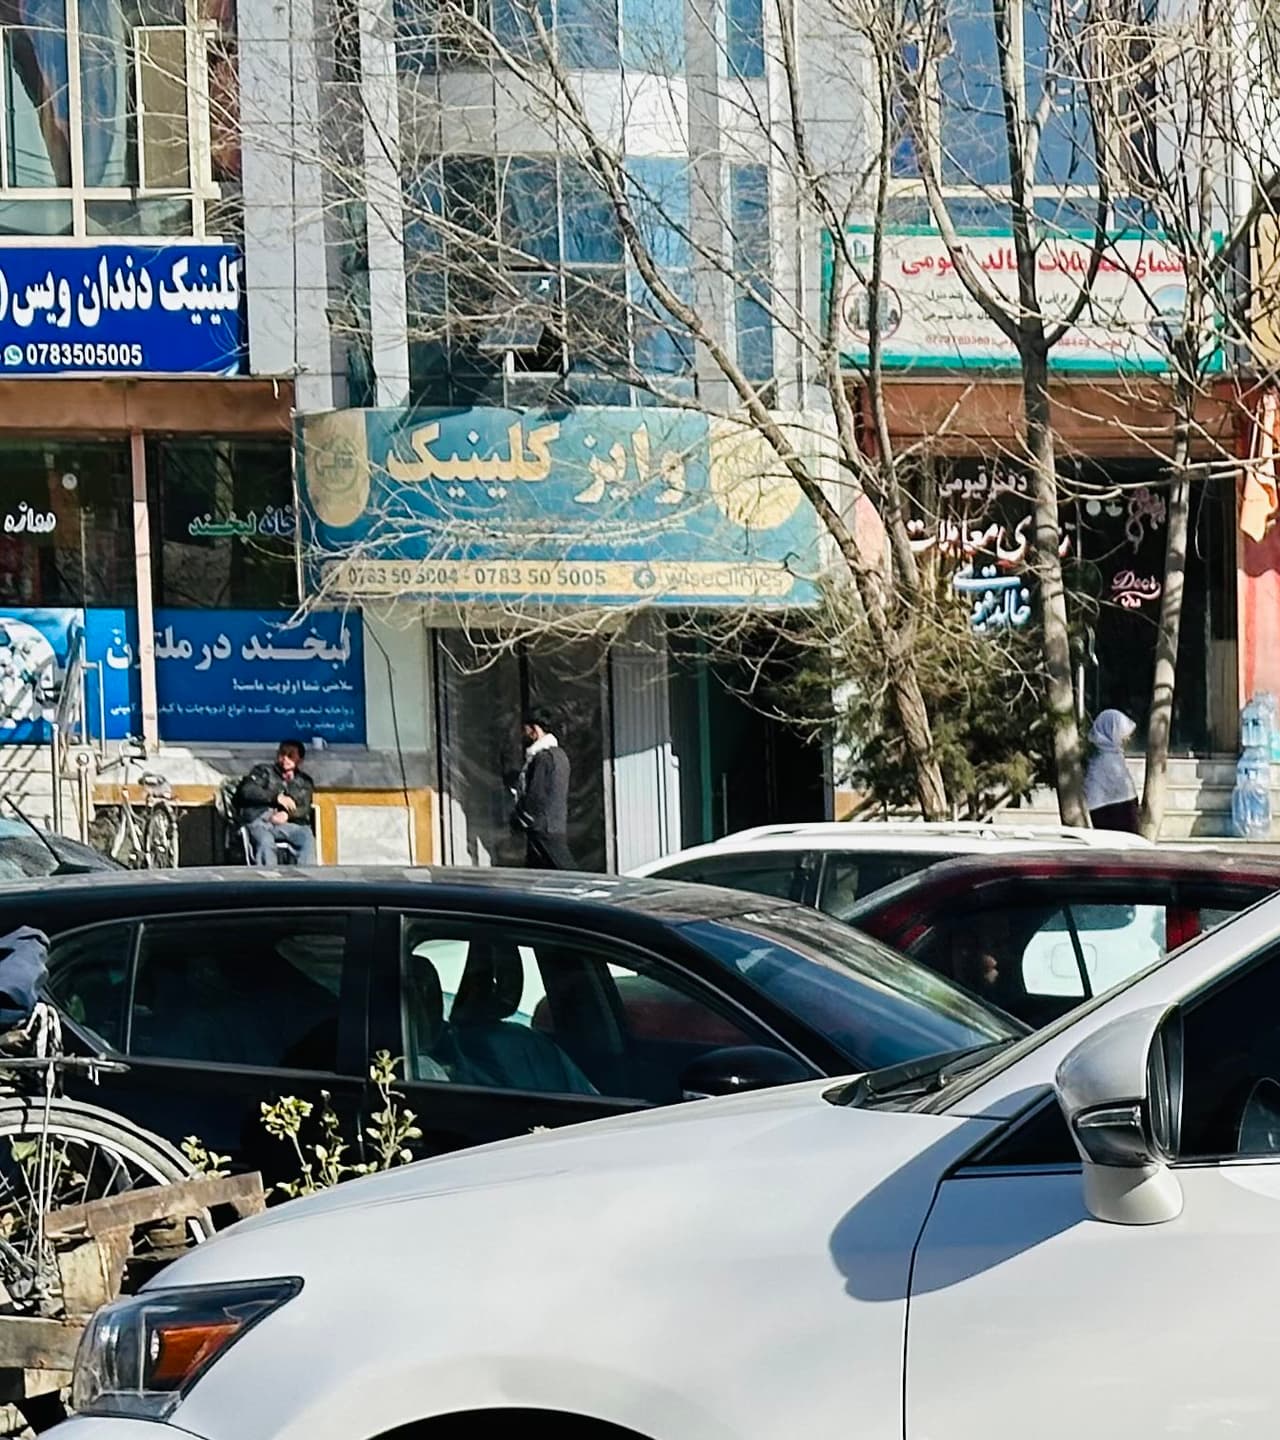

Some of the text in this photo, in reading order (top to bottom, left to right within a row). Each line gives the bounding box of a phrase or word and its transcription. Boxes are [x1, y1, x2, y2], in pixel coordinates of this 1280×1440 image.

[12, 254, 241, 328] کلینیک دندان ویس
[27, 344, 142, 366] 0783505005
[385, 421, 561, 499] کلینیک
[475, 569, 522, 587] 0783
[527, 568, 552, 586] 50
[557, 568, 607, 587] 5005
[241, 625, 353, 671] لبخند
[302, 680, 320, 692] شما
